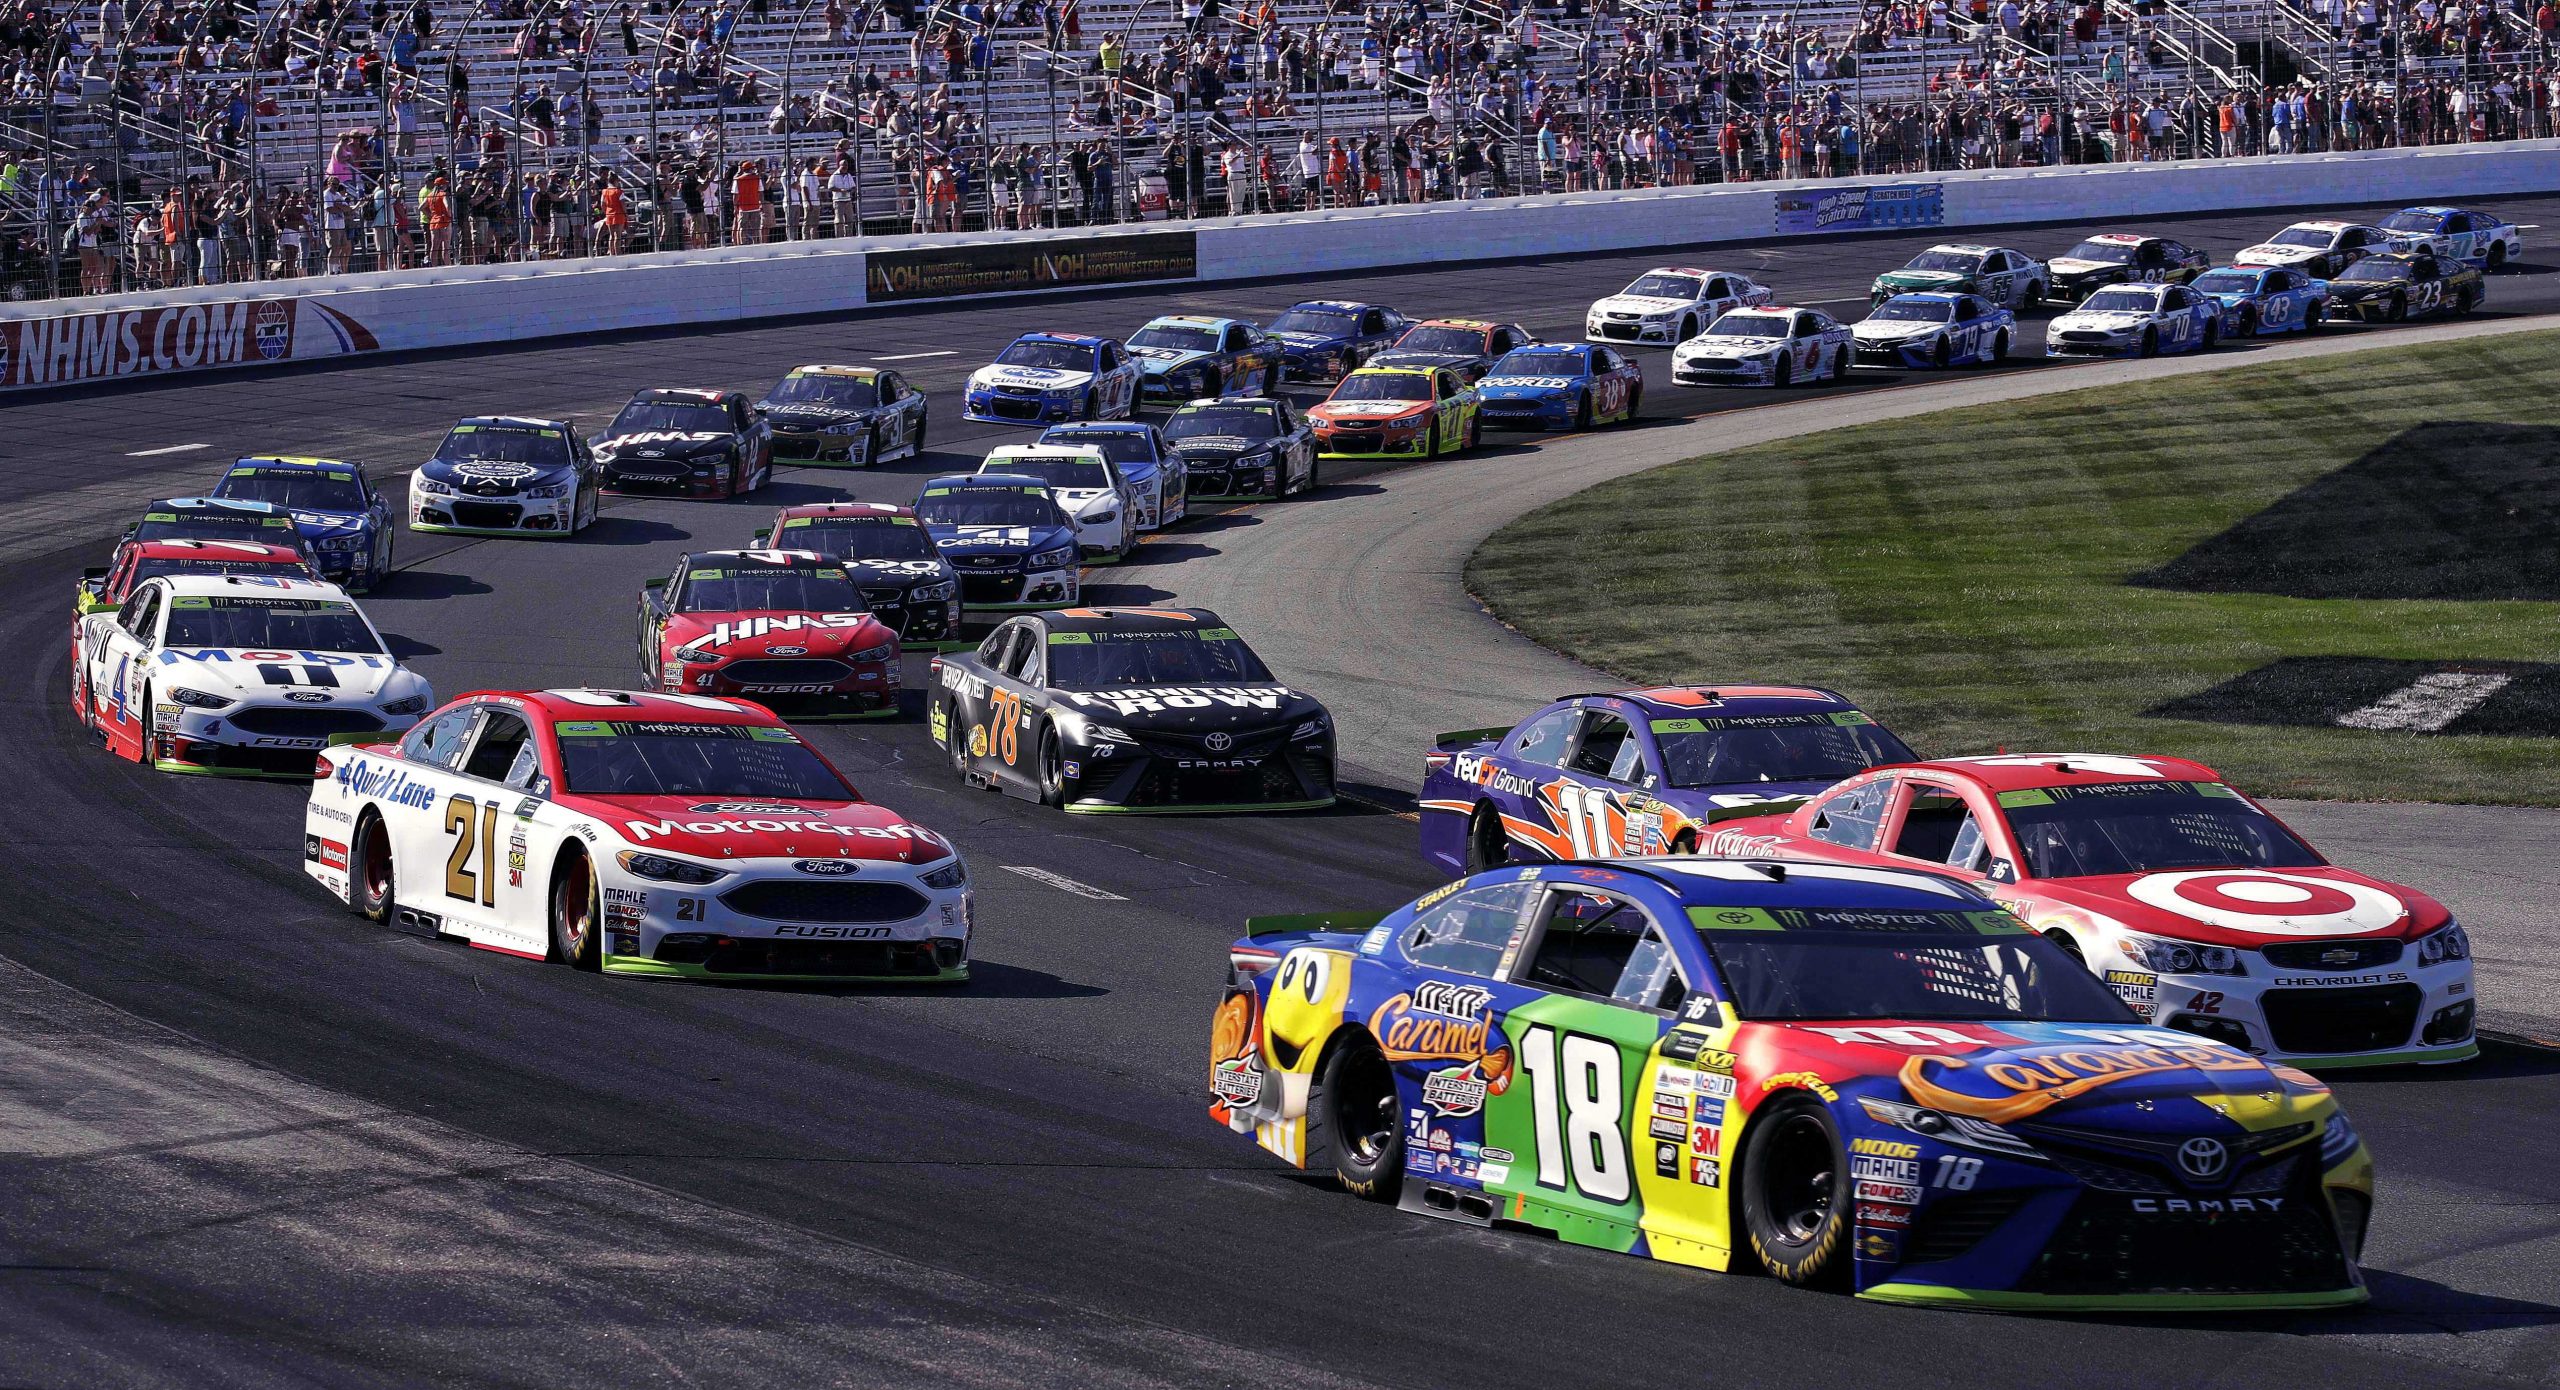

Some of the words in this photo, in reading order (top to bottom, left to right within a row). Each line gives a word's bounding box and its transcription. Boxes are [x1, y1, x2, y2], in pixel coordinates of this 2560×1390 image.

[1817, 193, 1837, 213] High
[1839, 189, 1868, 208] Speed
[1815, 207, 1846, 228] Scratch
[1847, 205, 1865, 220] Off
[1087, 251, 1128, 261] UNIVERSITY
[923, 263, 964, 273] UNIVERSITY
[1087, 258, 1167, 277] NORTHWESTERN
[1169, 256, 1194, 272] OHIO
[923, 271, 1003, 289] NORTHWESTERN
[1004, 270, 1029, 282] OHIO
[2420, 280, 2442, 310] 23
[2270, 296, 2290, 323] 43
[2172, 314, 2191, 343] 10
[16, 303, 248, 384] NHMS.COM
[991, 377, 1052, 390] ClickList
[1602, 379, 1619, 412] 38
[609, 431, 734, 449] HAAS
[194, 515, 245, 523] MONSTER
[936, 538, 1030, 548] Cessna
[196, 559, 254, 567] MONSTER
[683, 613, 872, 650] HAAS
[1113, 631, 1178, 640] MONSTER
[773, 646, 801, 655] Ford
[112, 652, 130, 726] 4
[696, 674, 715, 687] 41
[293, 691, 324, 701] Ford
[741, 685, 835, 695] FUSION
[1070, 686, 1303, 707] FURNITURE
[157, 704, 184, 714] MOOG
[1114, 695, 1279, 717] ROW
[156, 713, 181, 722] MAHLE
[988, 684, 1022, 767] 78
[1730, 715, 1804, 726] MONSTER
[204, 720, 221, 735] 4
[640, 723, 726, 735] MONSTER
[253, 737, 329, 748] FUSI
[1091, 743, 1115, 758] 78
[1178, 759, 1262, 769] CAMRY
[1454, 751, 1499, 787] FedEx
[1494, 768, 1536, 799] Ground
[1642, 775, 1657, 789] 16
[352, 760, 397, 799] Quick
[388, 771, 436, 811] Lane
[534, 778, 550, 795] 16
[2076, 783, 2161, 795] MONSTER
[308, 801, 320, 815] TIRE
[320, 805, 325, 816] &
[325, 807, 340, 821] AUTO
[718, 802, 813, 814] Ford
[1559, 784, 1613, 860] 11
[624, 817, 940, 847] Motorcraft
[445, 793, 502, 909] 21
[1644, 845, 1656, 856] 3M
[806, 860, 846, 874] Ford
[1992, 861, 2009, 879] 16
[509, 869, 522, 889] 3M
[605, 888, 648, 905] MAHLE
[1416, 877, 1470, 912] STANLEY
[607, 904, 639, 917] COMP
[677, 897, 706, 923] 21
[1815, 911, 1936, 926] MONSTER
[774, 925, 893, 938] FUSION
[2108, 971, 2156, 986] MOOG
[2274, 973, 2382, 986] CHEVROLET
[2387, 973, 2408, 983] SS
[2110, 985, 2154, 1000] MAHLE
[1685, 996, 1713, 1020] 16
[2187, 991, 2224, 1014] 42
[1368, 993, 1493, 1056] Caramel
[1216, 1069, 1260, 1087] INTERSTATE
[1429, 1075, 1484, 1096] INTERSTATE
[1694, 1072, 1723, 1091] Mobil
[1899, 1042, 2268, 1124] Caramel
[1217, 1080, 1257, 1099] BATTERIES
[1761, 1071, 1840, 1104] GOODYEAR
[1428, 1089, 1480, 1107] BATTERIES
[1520, 1022, 1633, 1207] 18
[1693, 1126, 1720, 1157] 3M
[1848, 1138, 1922, 1159] MOOG
[1856, 1157, 1919, 1181] MAHLE
[1931, 1154, 1985, 1191] 18
[1859, 1184, 1904, 1200] COMP
[1856, 1205, 1912, 1225] Edelbrock
[2131, 1198, 2285, 1214] CAMRY
